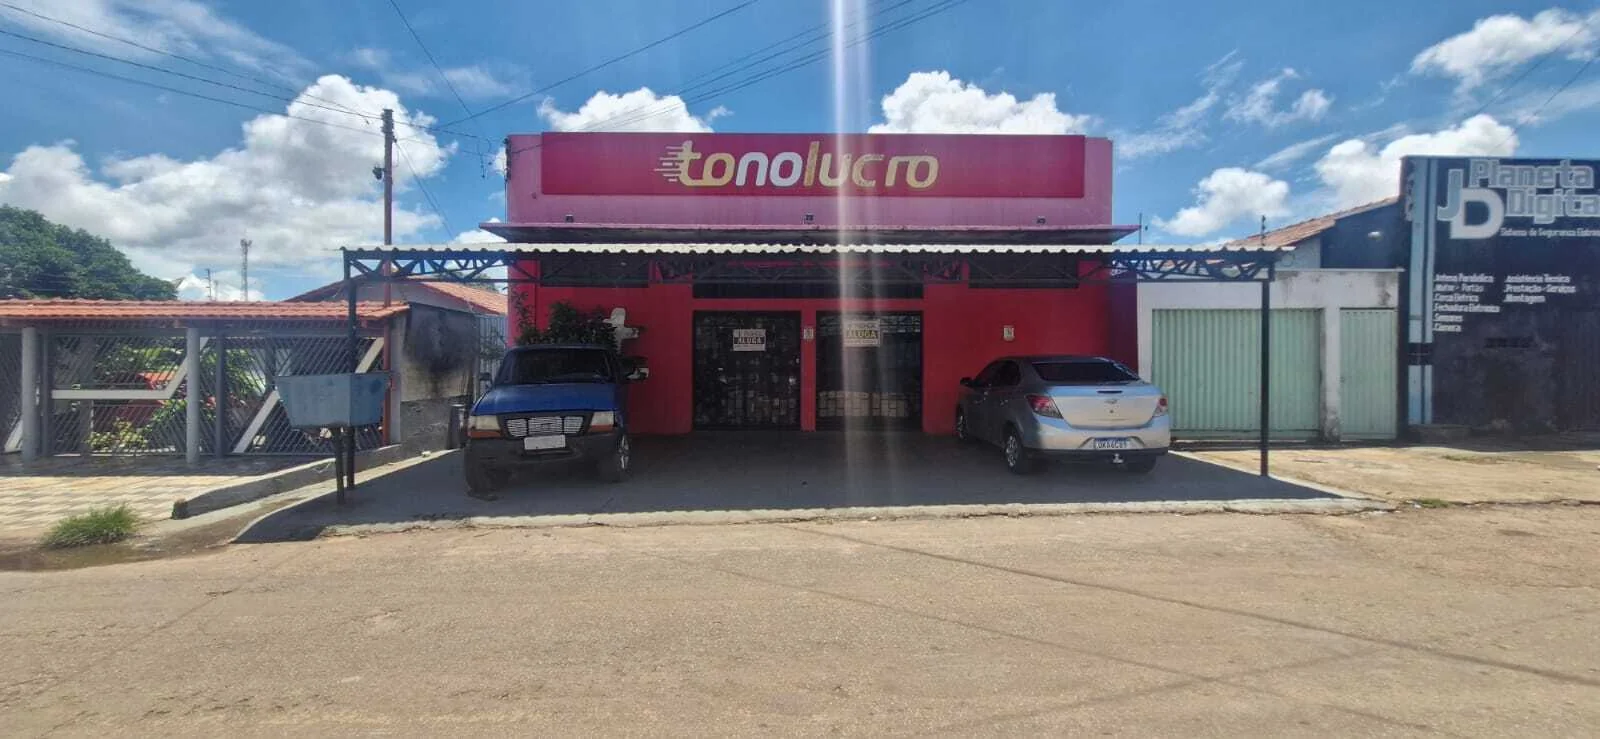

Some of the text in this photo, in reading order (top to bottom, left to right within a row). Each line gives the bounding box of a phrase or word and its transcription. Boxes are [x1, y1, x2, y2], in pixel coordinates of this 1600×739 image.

[678, 139, 939, 188] tonolucro
[1469, 158, 1594, 189] Planeta
[1505, 187, 1600, 224] Digita
